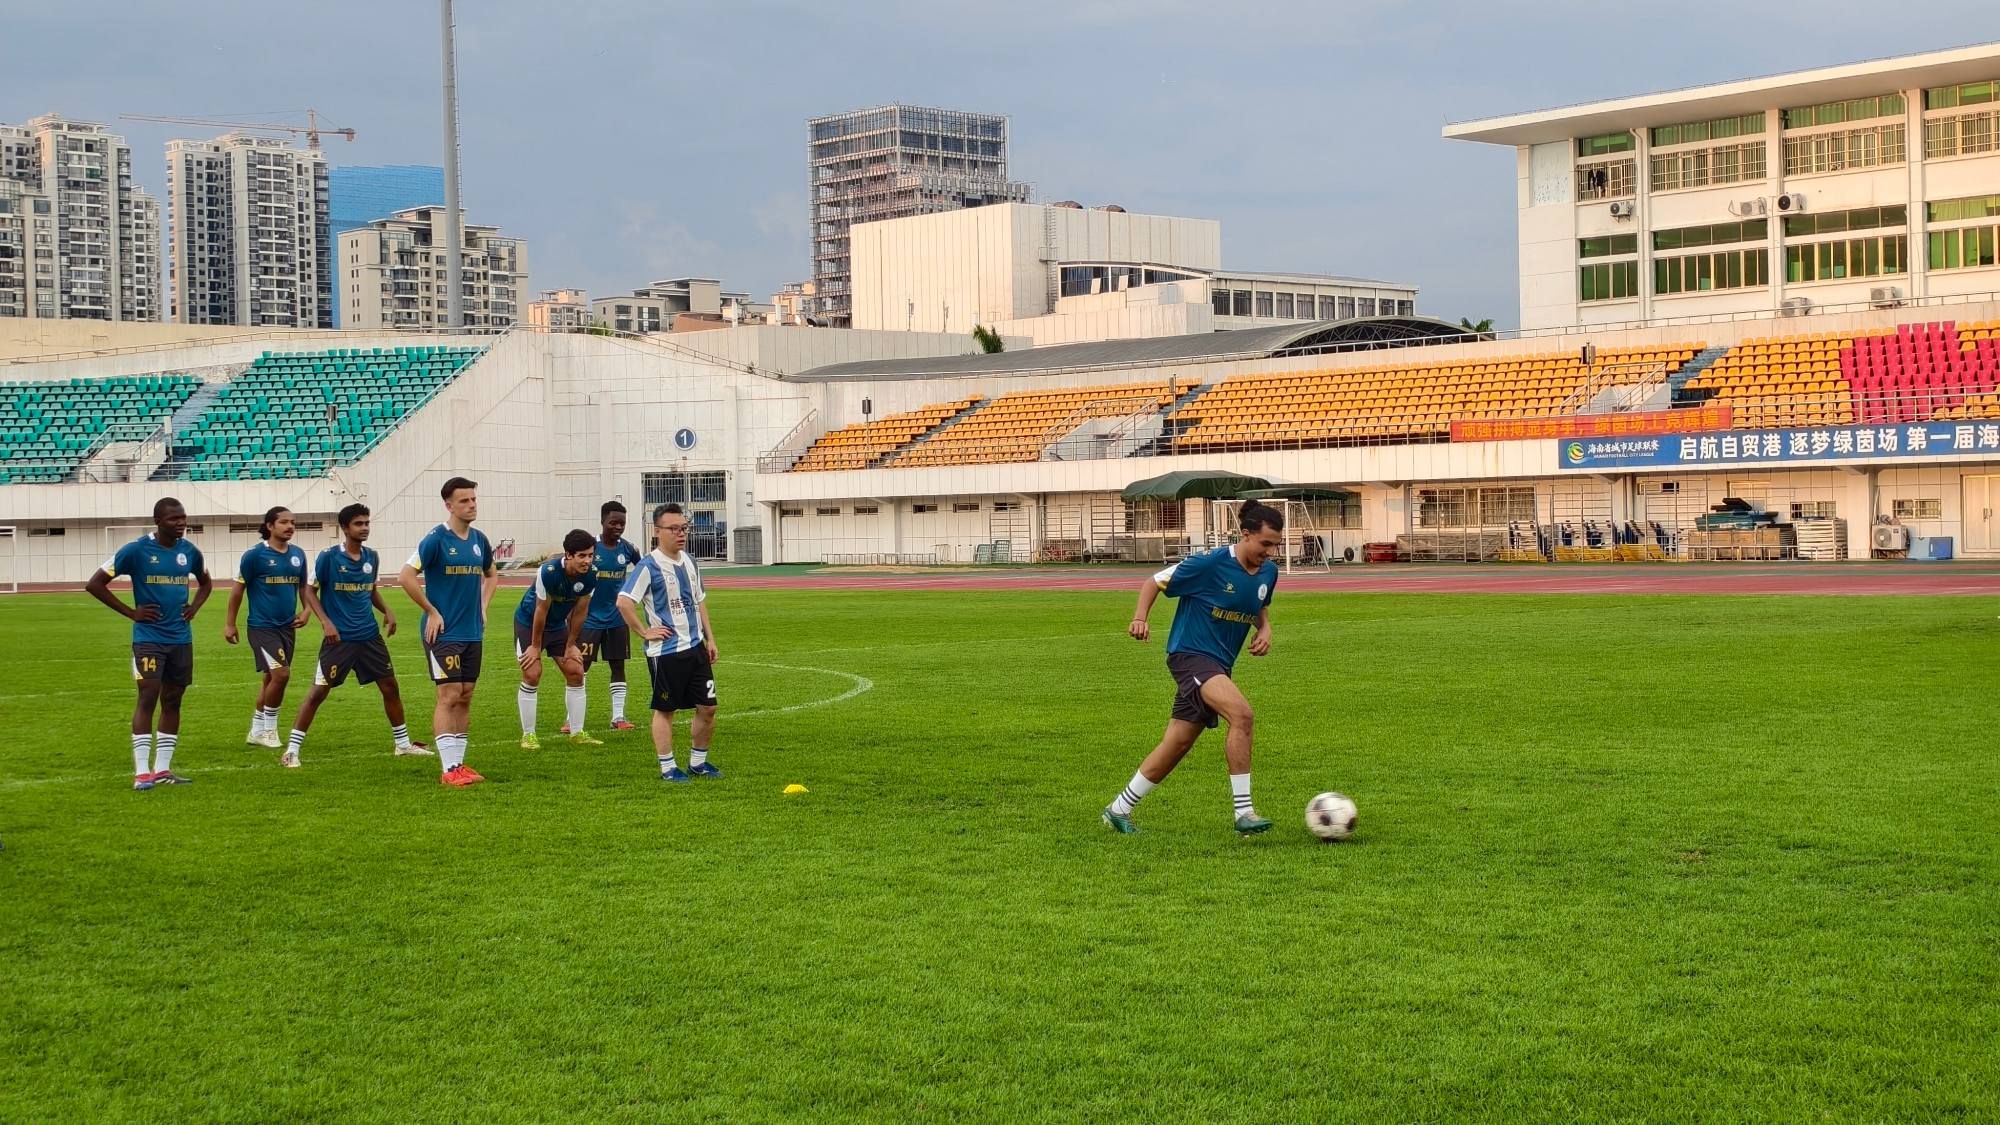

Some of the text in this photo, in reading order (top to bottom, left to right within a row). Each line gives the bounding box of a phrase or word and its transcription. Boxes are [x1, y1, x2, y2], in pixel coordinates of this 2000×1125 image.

[680, 430, 687, 446] 1
[1679, 424, 1999, 460] 启航自贸港 逐梦绿茵场 第一届海
[1587, 440, 1660, 455] 海南省城市足球联赛
[278, 647, 286, 661] 9
[581, 642, 594, 656] 21
[141, 655, 157, 672] 14
[445, 655, 461, 671] 90
[330, 664, 338, 679] 8
